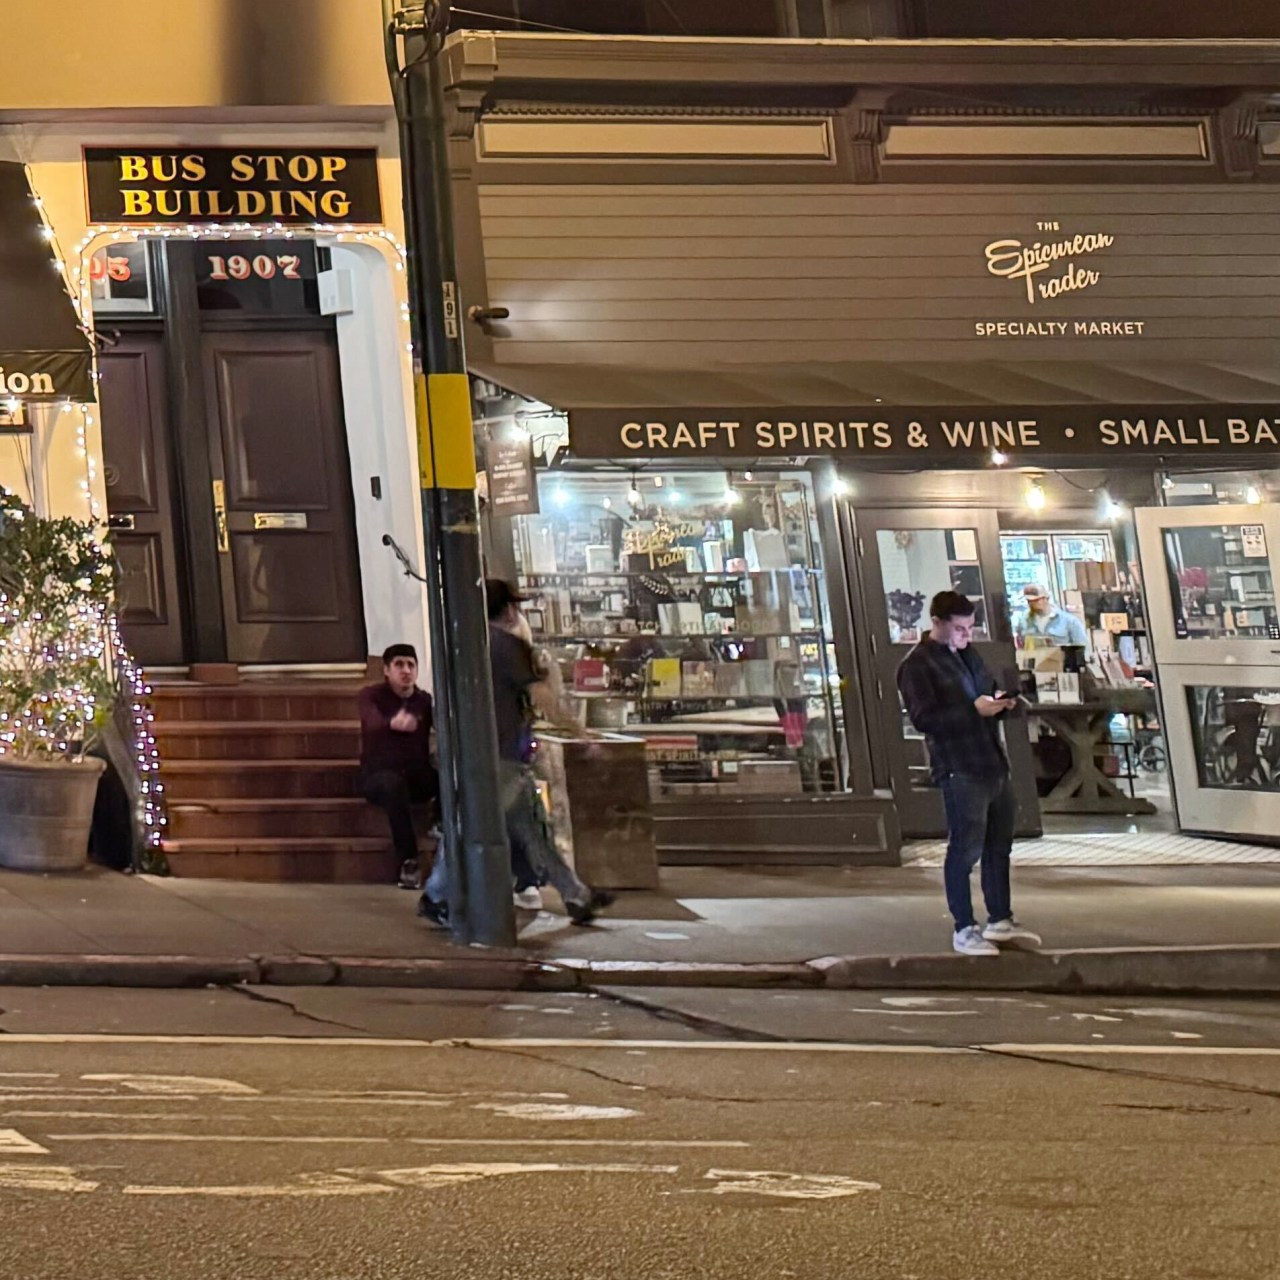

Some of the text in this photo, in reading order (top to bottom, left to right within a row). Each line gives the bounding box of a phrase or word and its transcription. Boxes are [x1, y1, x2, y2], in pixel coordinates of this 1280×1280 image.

[119, 154, 348, 182] BUS STOP
[119, 189, 352, 218] BUILDING
[1036, 221, 1060, 231] THE
[208, 254, 301, 280] 1907
[984, 233, 1114, 276] Epicurean
[1008, 263, 1100, 304] Trader
[975, 321, 1145, 336] SPECIALTY MARKET
[620, 418, 1280, 449] CRAFT SPIRITS & WINE SMALL BA
